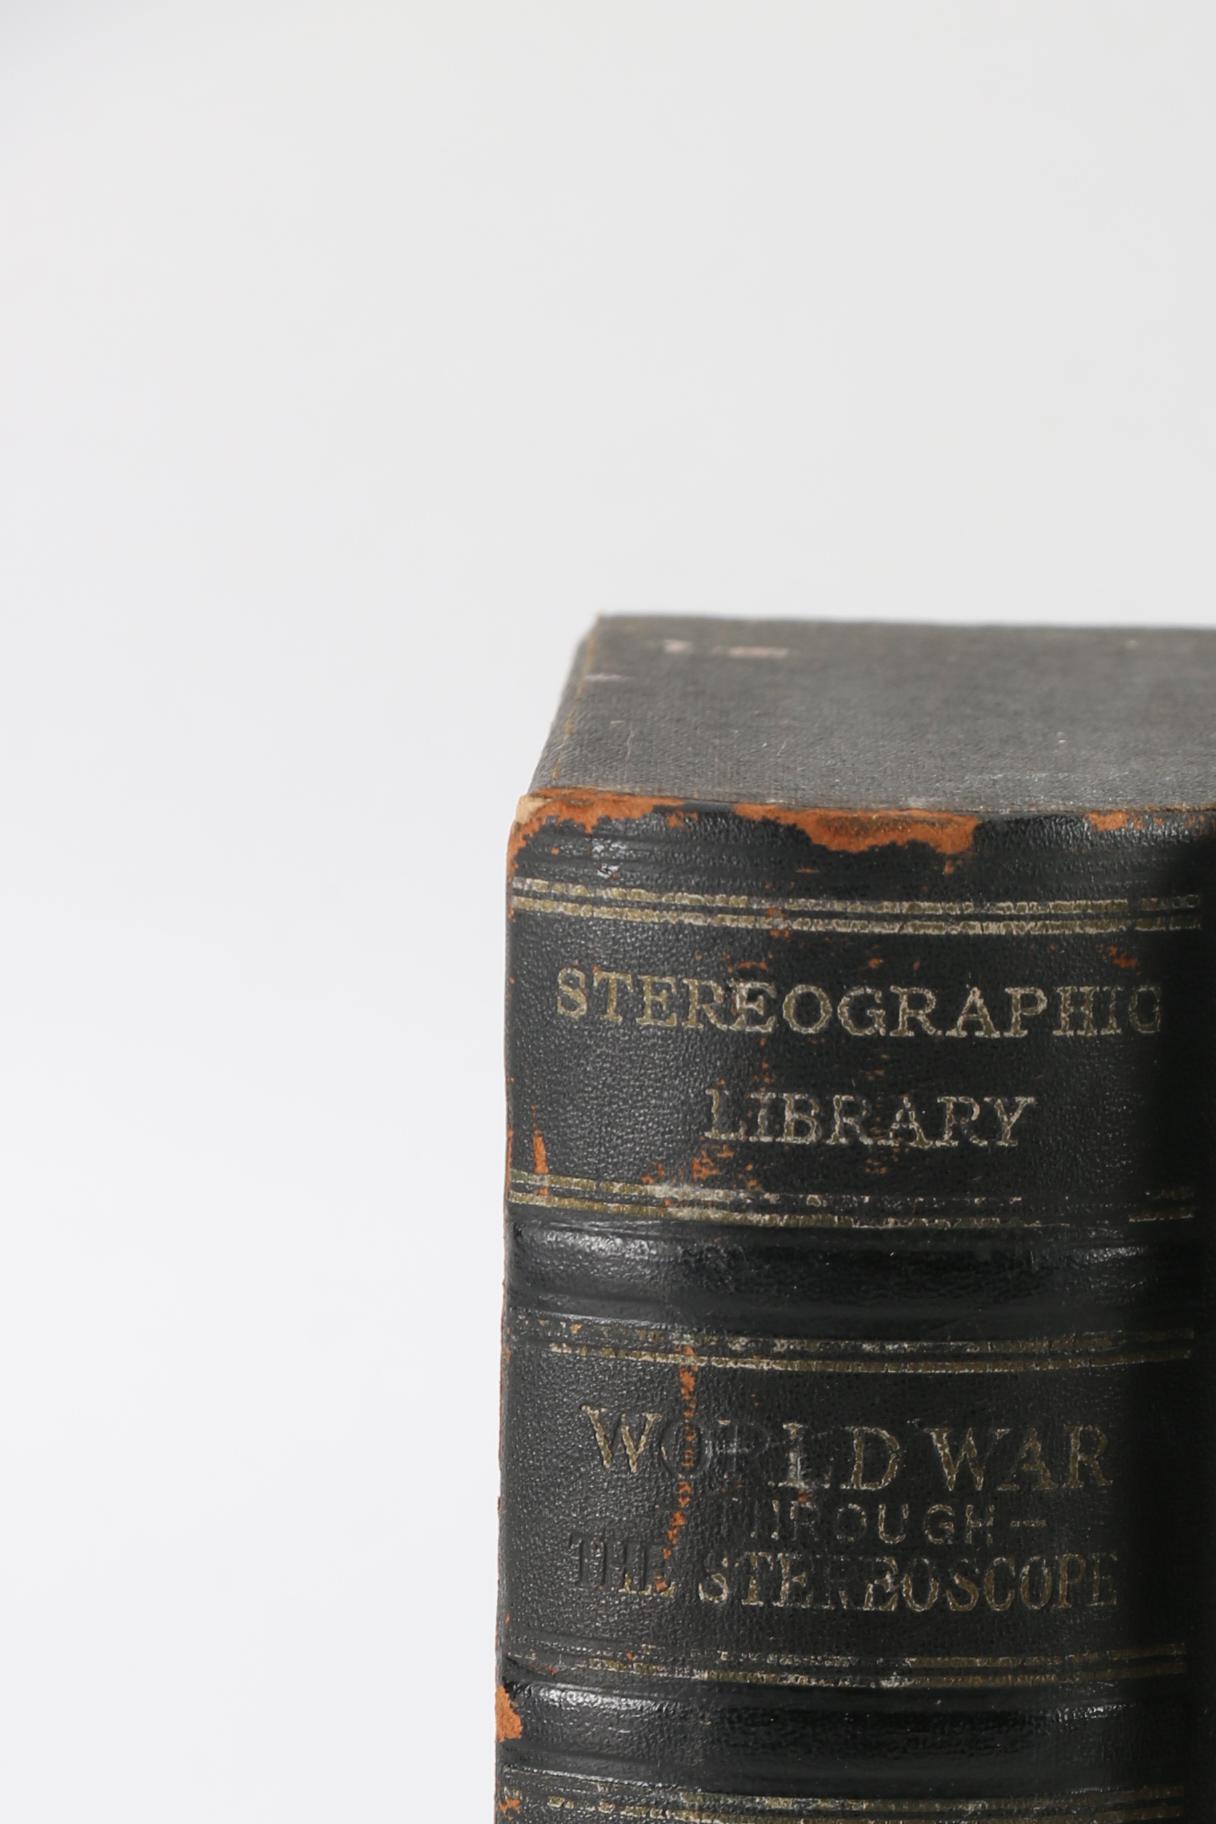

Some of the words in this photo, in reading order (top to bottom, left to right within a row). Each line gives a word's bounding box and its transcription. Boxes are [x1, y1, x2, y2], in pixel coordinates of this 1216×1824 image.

[556, 967, 1162, 1039] STEREOGRAPHIC
[701, 1087, 1035, 1149] LIBRARY
[579, 1403, 902, 1492] WORLD
[920, 1422, 1114, 1492] WAR
[698, 1550, 1119, 1613] STEREOSCOPE
